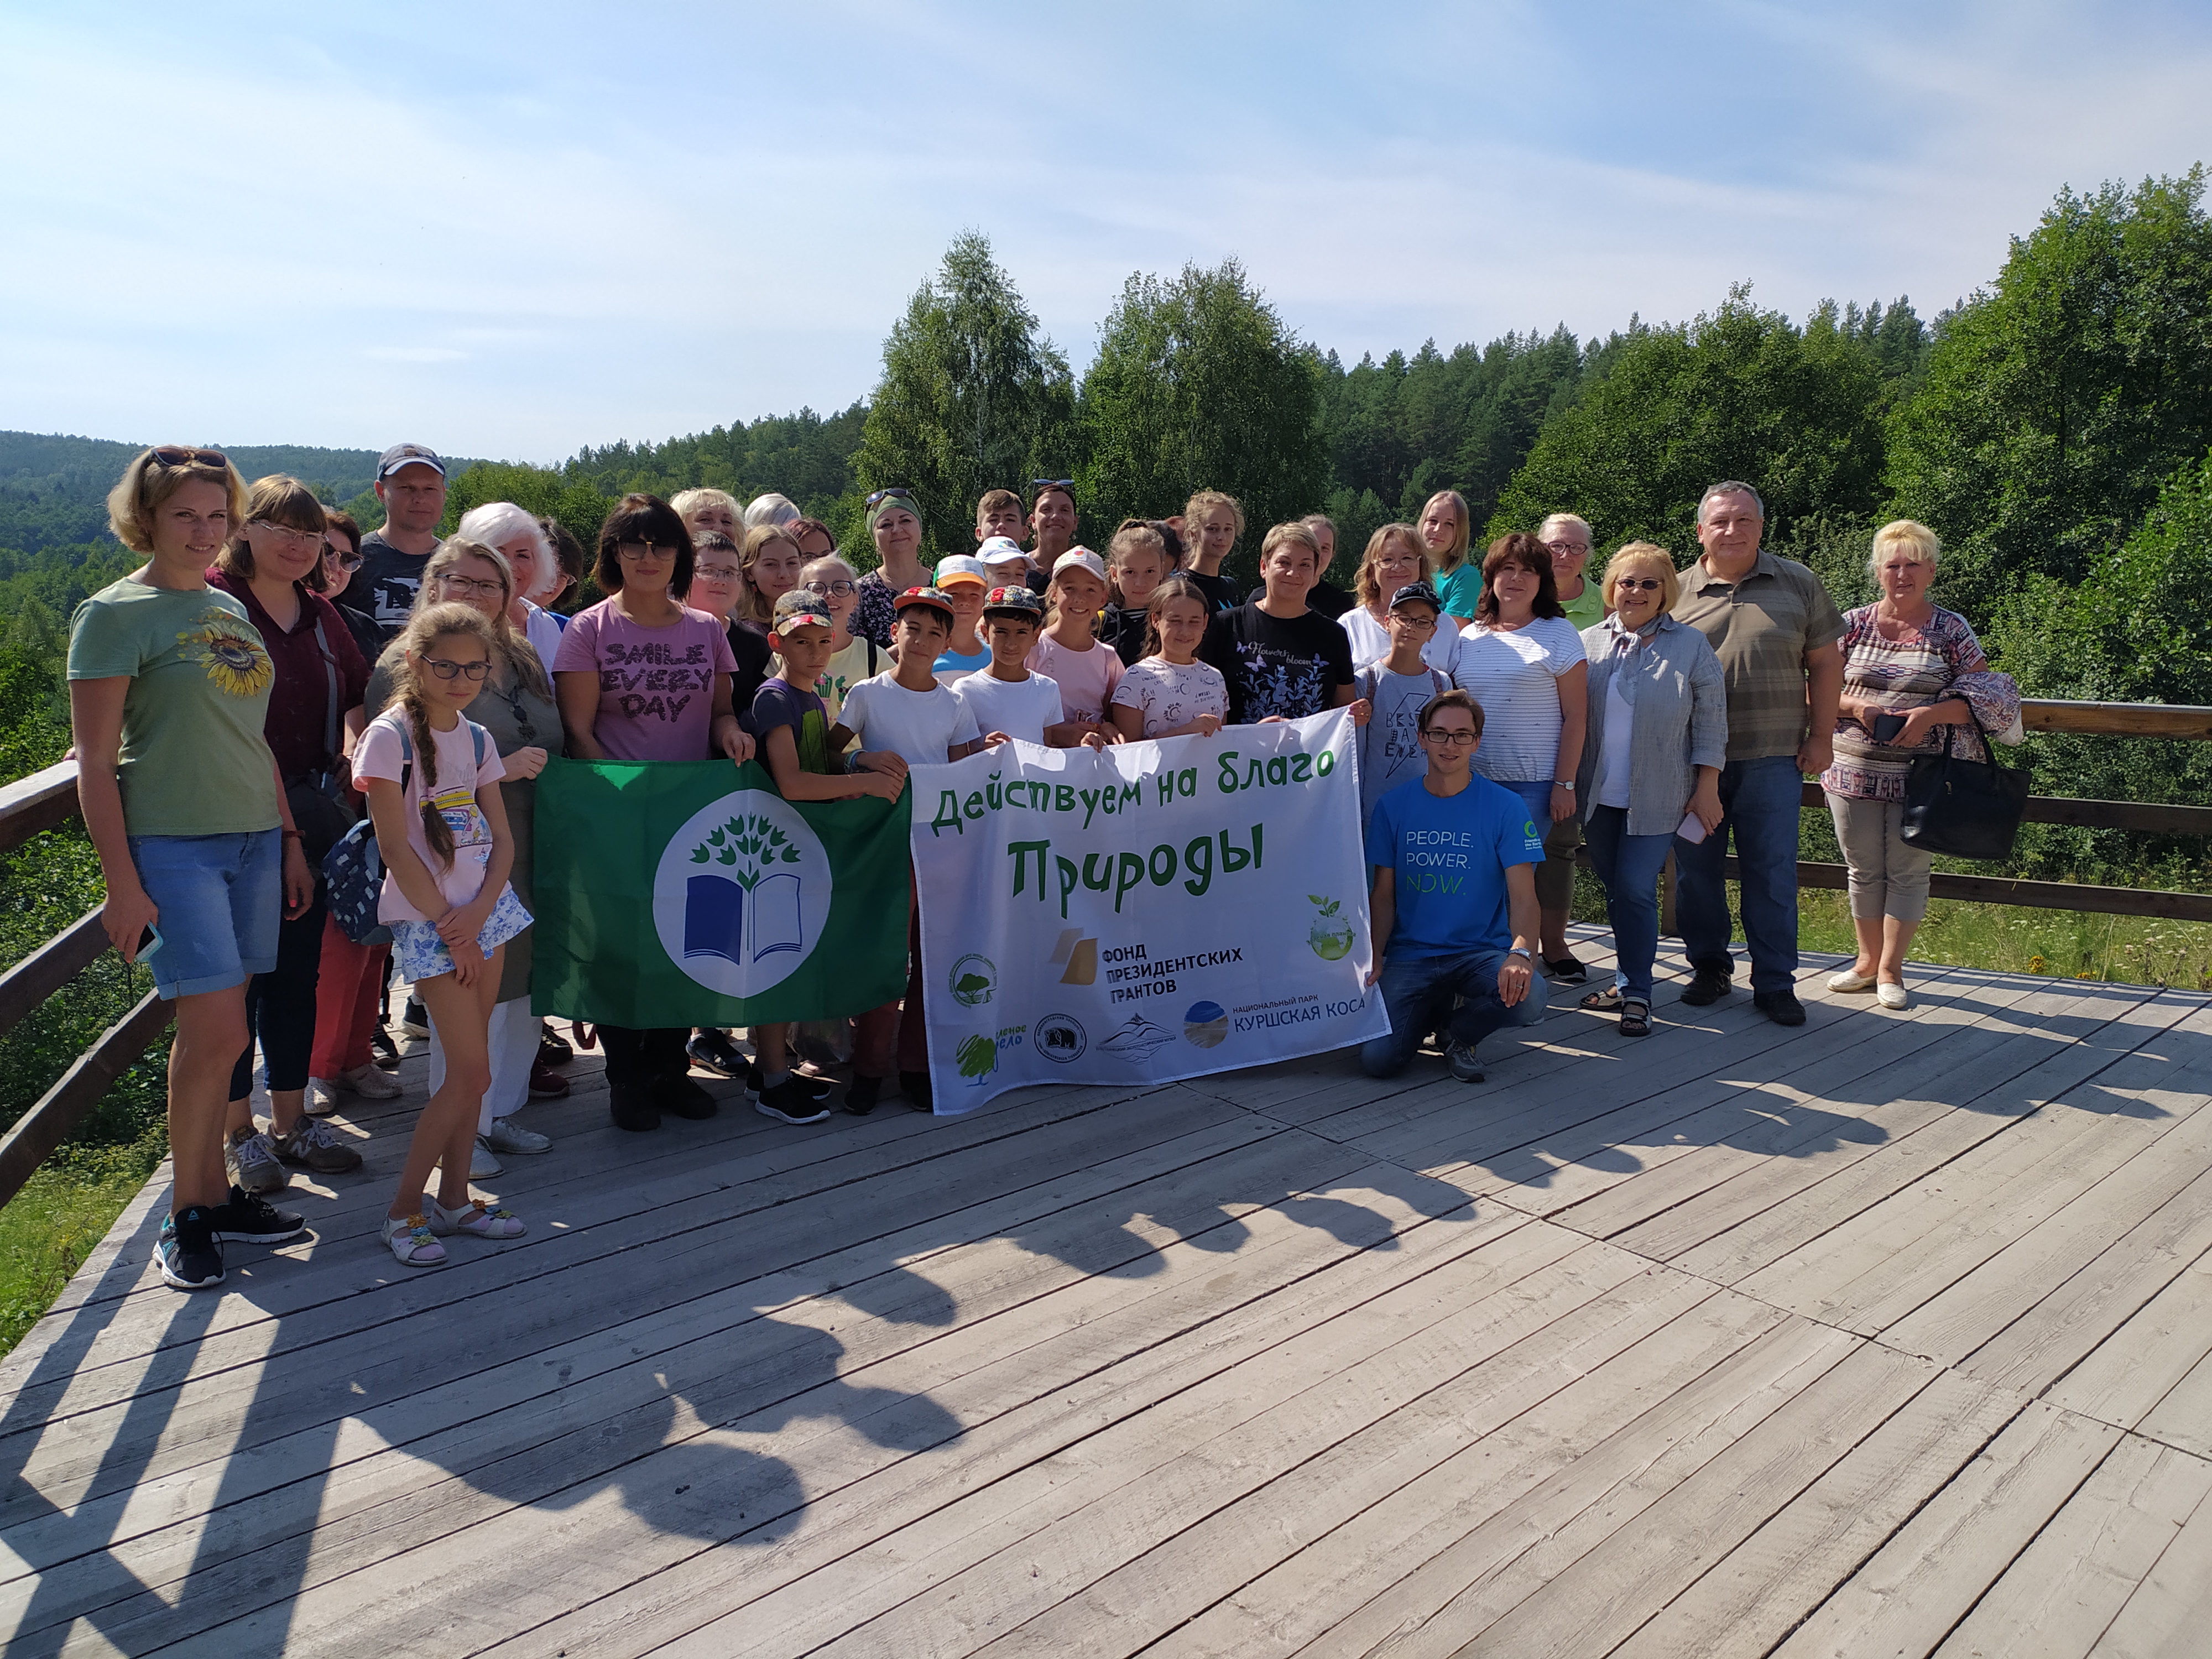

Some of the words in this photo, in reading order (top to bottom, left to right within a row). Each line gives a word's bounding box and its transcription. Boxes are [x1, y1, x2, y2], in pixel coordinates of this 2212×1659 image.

[605, 643, 707, 665] SMILE
[1248, 641, 1289, 657] Flowers
[1286, 654, 1314, 666] bloom
[601, 668, 713, 693] EVERY
[618, 693, 691, 723] DAY
[931, 770, 1141, 837] Действуем
[1157, 767, 1197, 807] на
[1217, 750, 1334, 794] благо
[1406, 830, 1474, 848] PEOPLE.
[1008, 822, 1263, 920] Природы
[1406, 852, 1471, 869] POWER.
[1406, 874, 1466, 896] NOW.
[1102, 944, 1147, 963] ФОНД
[1105, 948, 1243, 984] ПРЕЗИДЕНТСКИХ
[1110, 979, 1177, 1004] ГРАНТОВ
[1232, 997, 1297, 1014] НАЦИОНАЛЬНЫЙ
[1298, 994, 1319, 1004] ПАРК
[1234, 1006, 1321, 1032] КУРШСКАЯ
[1326, 997, 1365, 1018] КОСА
